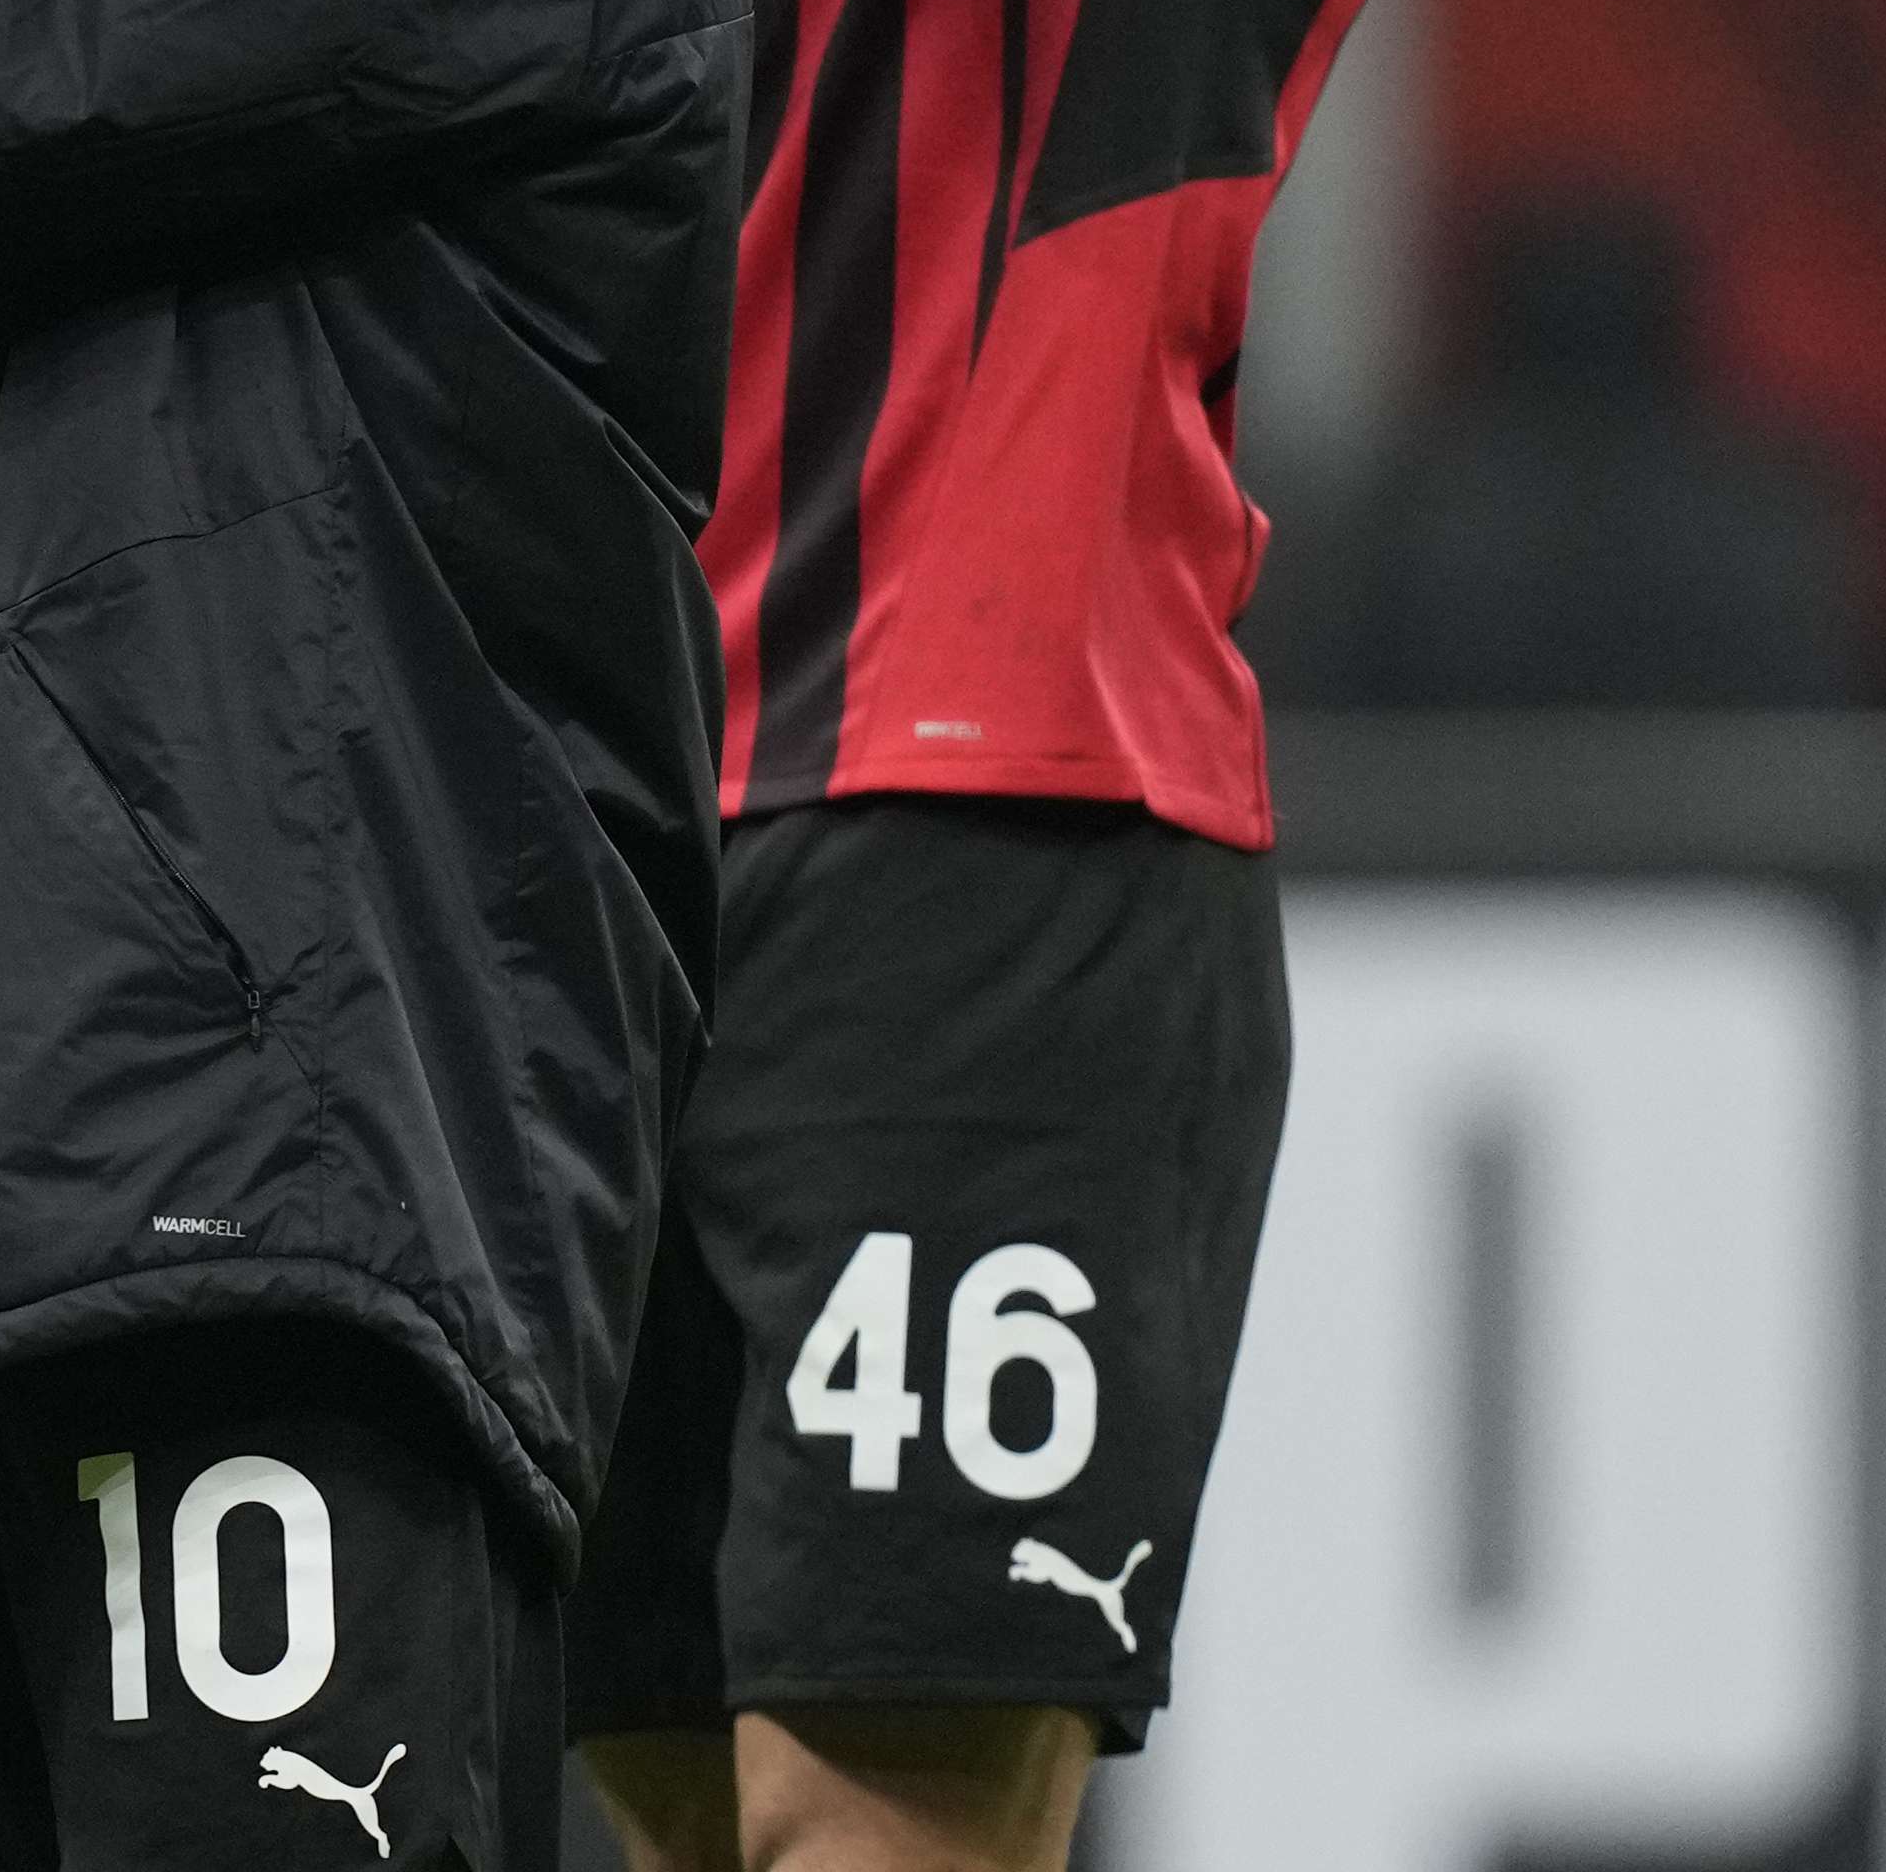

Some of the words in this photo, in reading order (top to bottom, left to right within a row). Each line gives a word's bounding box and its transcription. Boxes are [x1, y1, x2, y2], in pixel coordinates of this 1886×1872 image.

[152, 1215, 247, 1238] WARMCELL
[785, 1231, 1099, 1501] 46
[77, 1451, 337, 1723] 10
